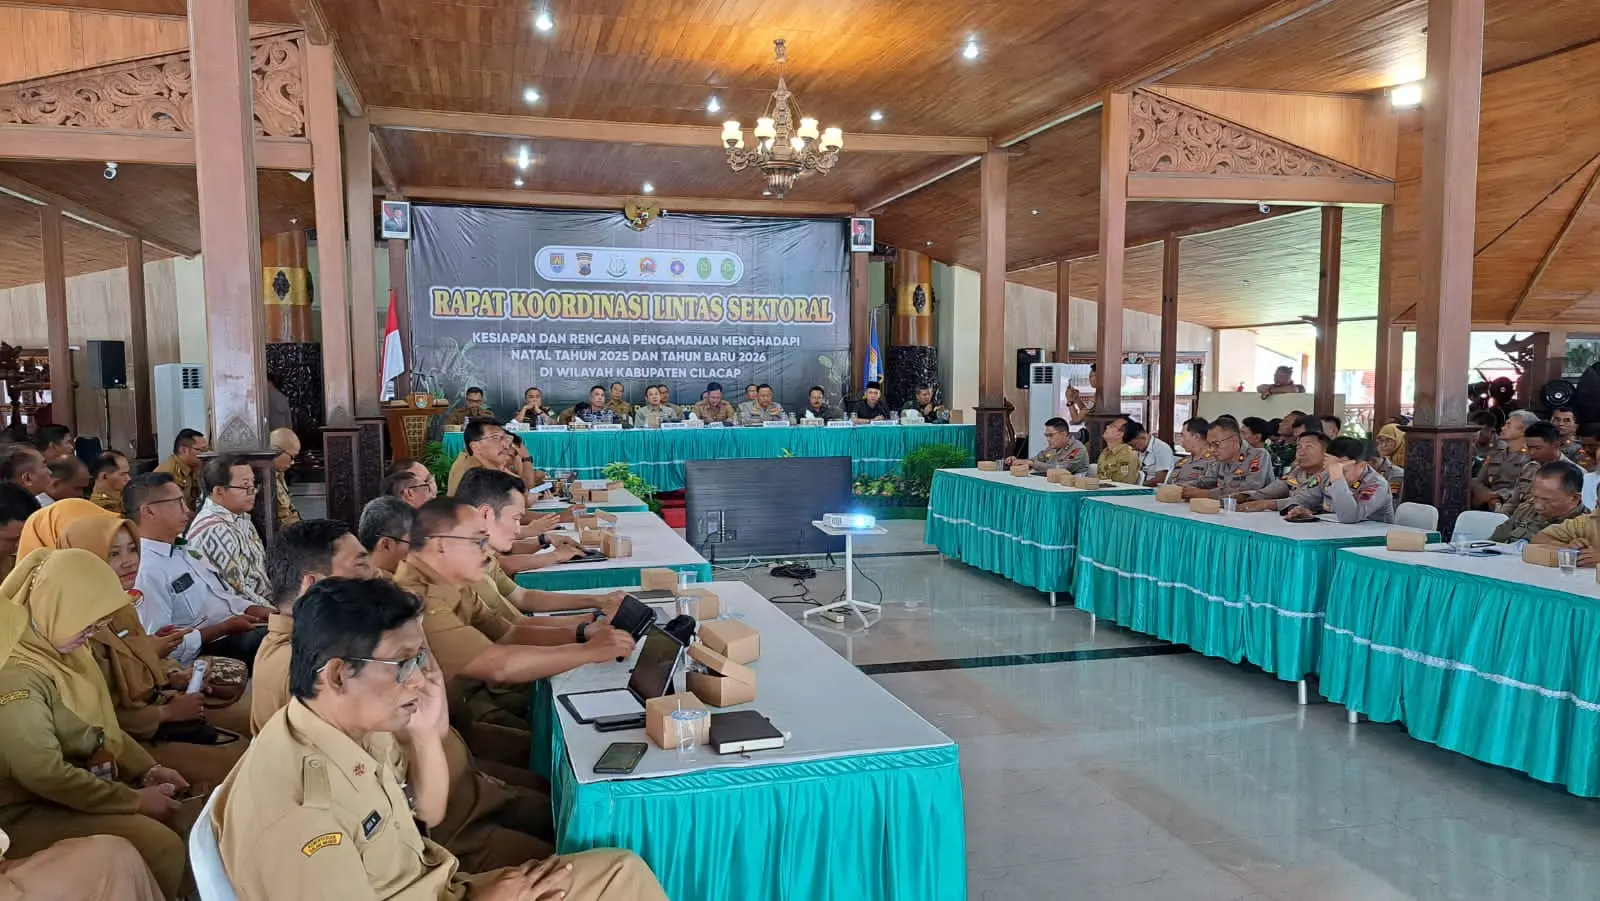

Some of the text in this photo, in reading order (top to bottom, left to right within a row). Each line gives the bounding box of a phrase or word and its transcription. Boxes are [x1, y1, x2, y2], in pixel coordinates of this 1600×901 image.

[431, 288, 833, 323] RAPAT KOORDINASI LINTAS SEKTORAL
[472, 332, 800, 347] KESIAPAN DAN RENCANA PENGAMANAN MENGHADAPI
[511, 350, 767, 362] NATAL TAHUN 2025 DAN TAHUN BARU 2026
[540, 367, 741, 379] DI WILAYAH KABUPATEN CILACAP
